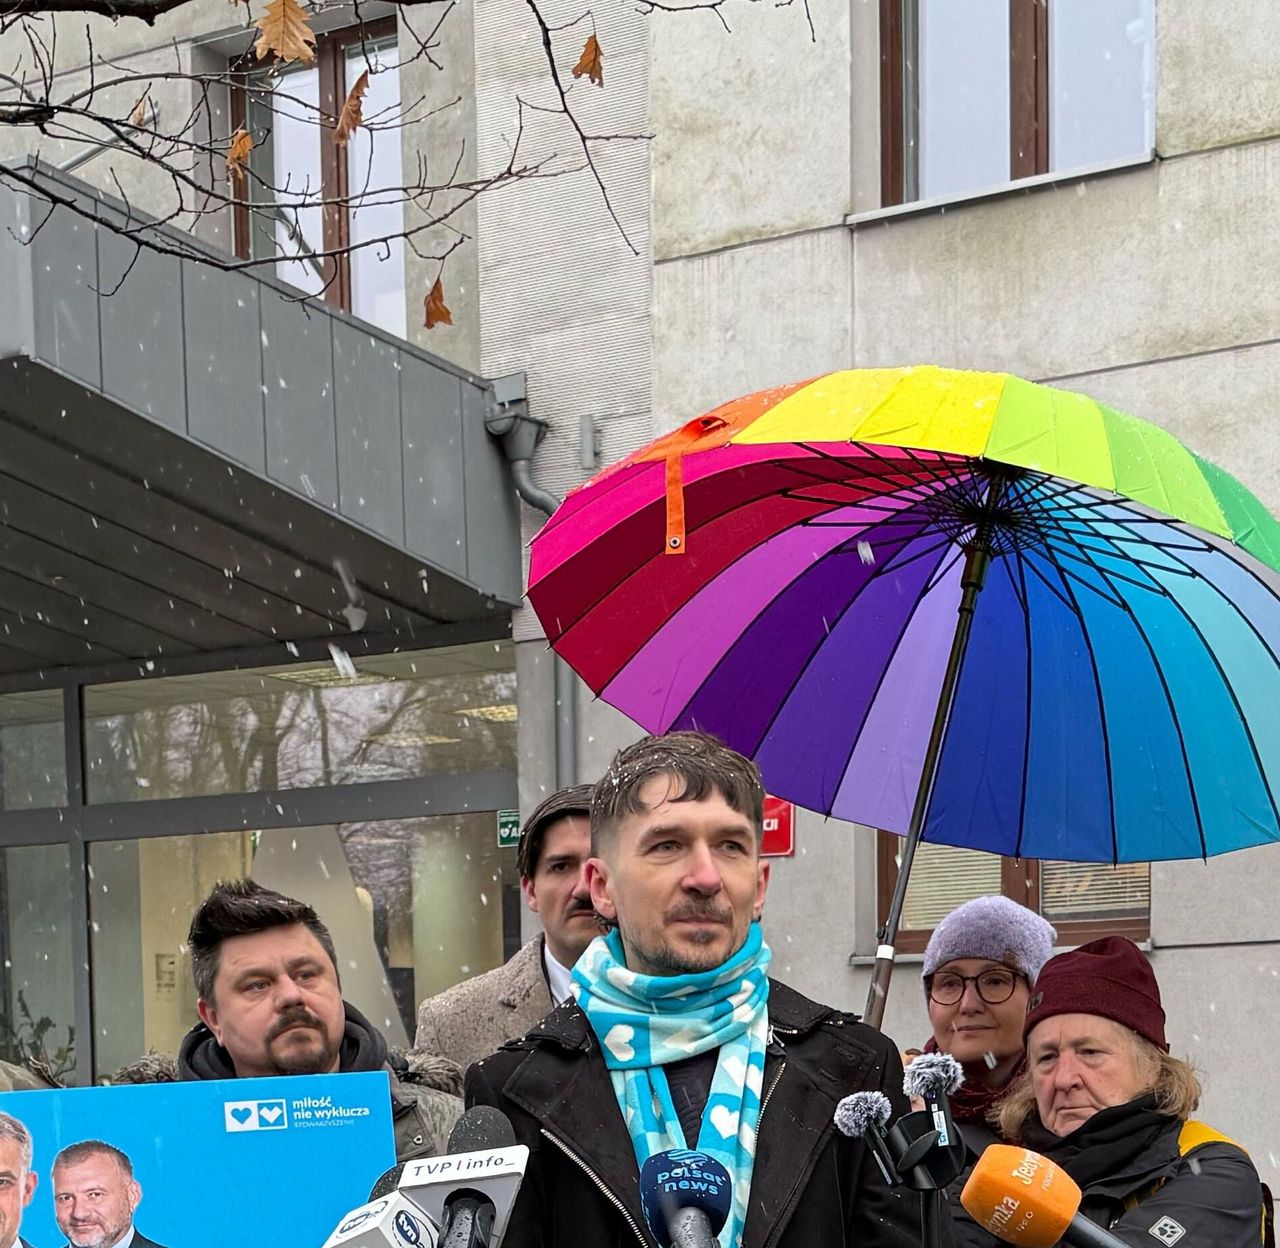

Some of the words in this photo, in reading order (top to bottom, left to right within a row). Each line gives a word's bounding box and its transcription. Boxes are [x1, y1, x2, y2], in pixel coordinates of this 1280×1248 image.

[293, 1096, 331, 1110] miłość
[294, 1109, 312, 1120] nie
[314, 1106, 370, 1120] wyklucza
[414, 1161, 451, 1177] TVP
[665, 1180, 718, 1195] news
